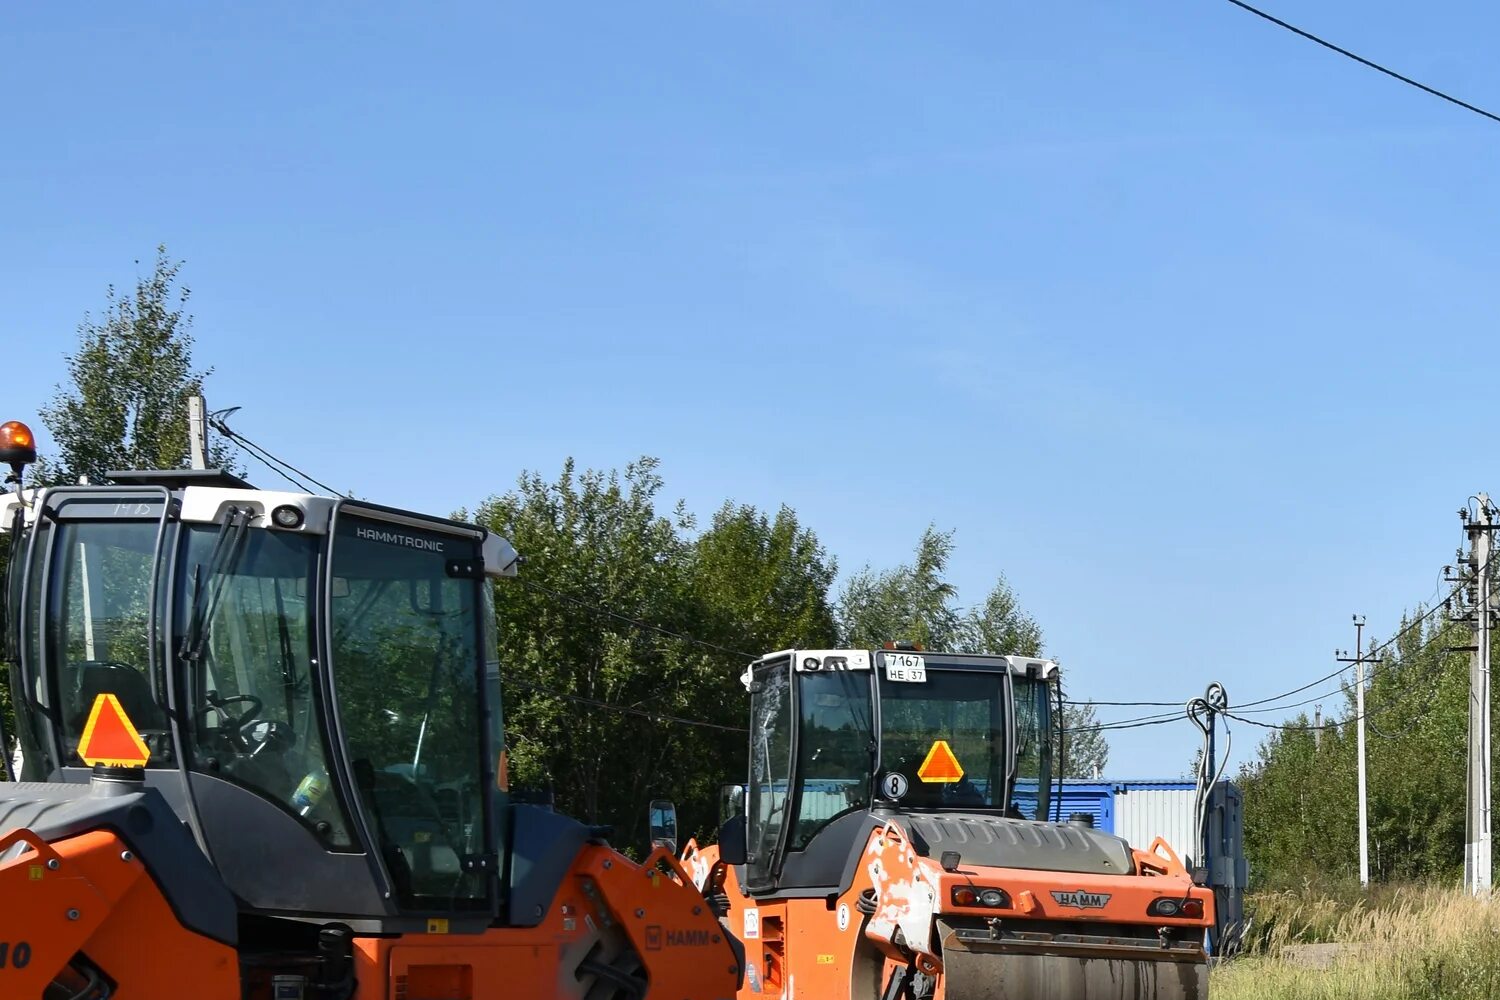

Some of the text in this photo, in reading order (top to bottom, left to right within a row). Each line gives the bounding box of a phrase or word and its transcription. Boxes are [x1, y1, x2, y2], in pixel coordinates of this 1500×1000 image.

[356, 527, 444, 552] HAMMTRONIC
[891, 655, 920, 667] 7167
[891, 777, 898, 795] 8
[1060, 894, 1102, 906] HAMM
[666, 929, 709, 946] HAMM
